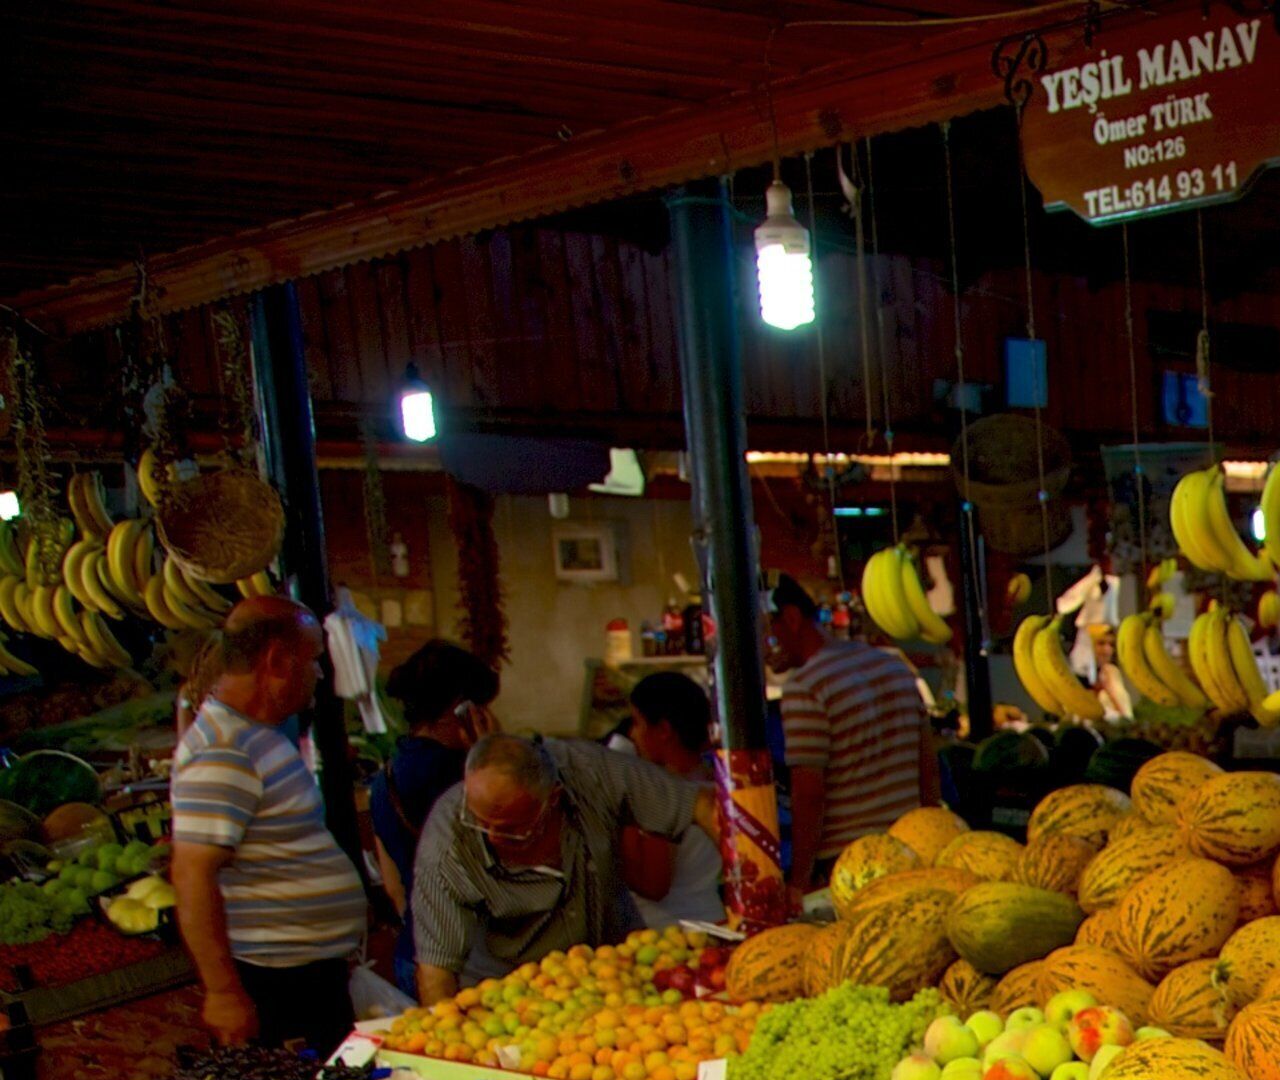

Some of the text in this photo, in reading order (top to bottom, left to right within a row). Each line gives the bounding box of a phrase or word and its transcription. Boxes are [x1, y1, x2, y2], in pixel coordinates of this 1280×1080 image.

[1040, 19, 1262, 114] YEŞİL MANAV
[1092, 92, 1213, 146] Ömer TÜRK
[1123, 136, 1186, 170] NO:126
[1083, 160, 1238, 217] TEL:614 93 11
